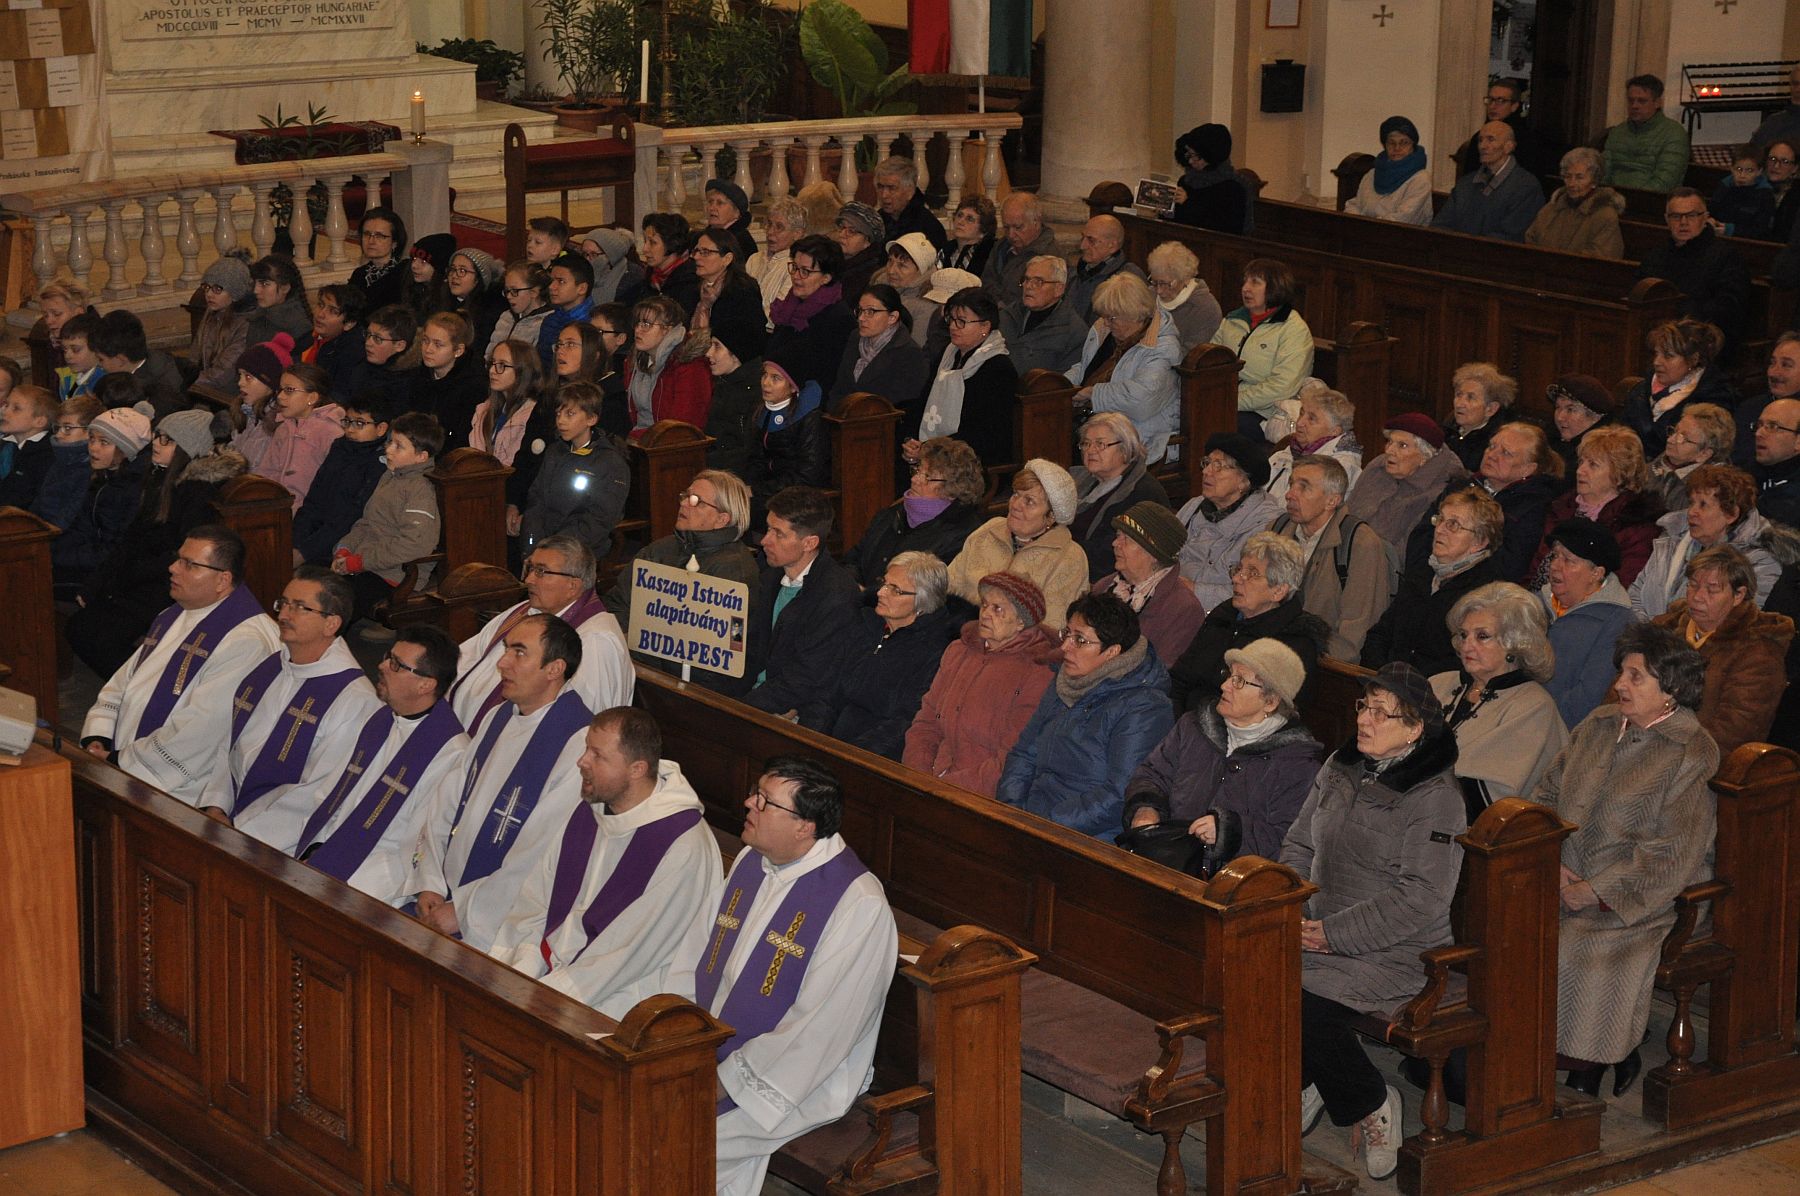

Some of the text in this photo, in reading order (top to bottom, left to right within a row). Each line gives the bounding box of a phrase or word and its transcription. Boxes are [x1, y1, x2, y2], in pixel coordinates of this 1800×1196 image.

[217, 8, 231, 17] ET
[238, 5, 311, 16] PRAECEPTOR
[247, 18, 282, 28] MCMV
[311, 15, 365, 25] MCMXXVII
[636, 567, 743, 611] Kaszap István
[646, 598, 729, 638] alapítvány
[638, 629, 734, 671] BUDAPEST
